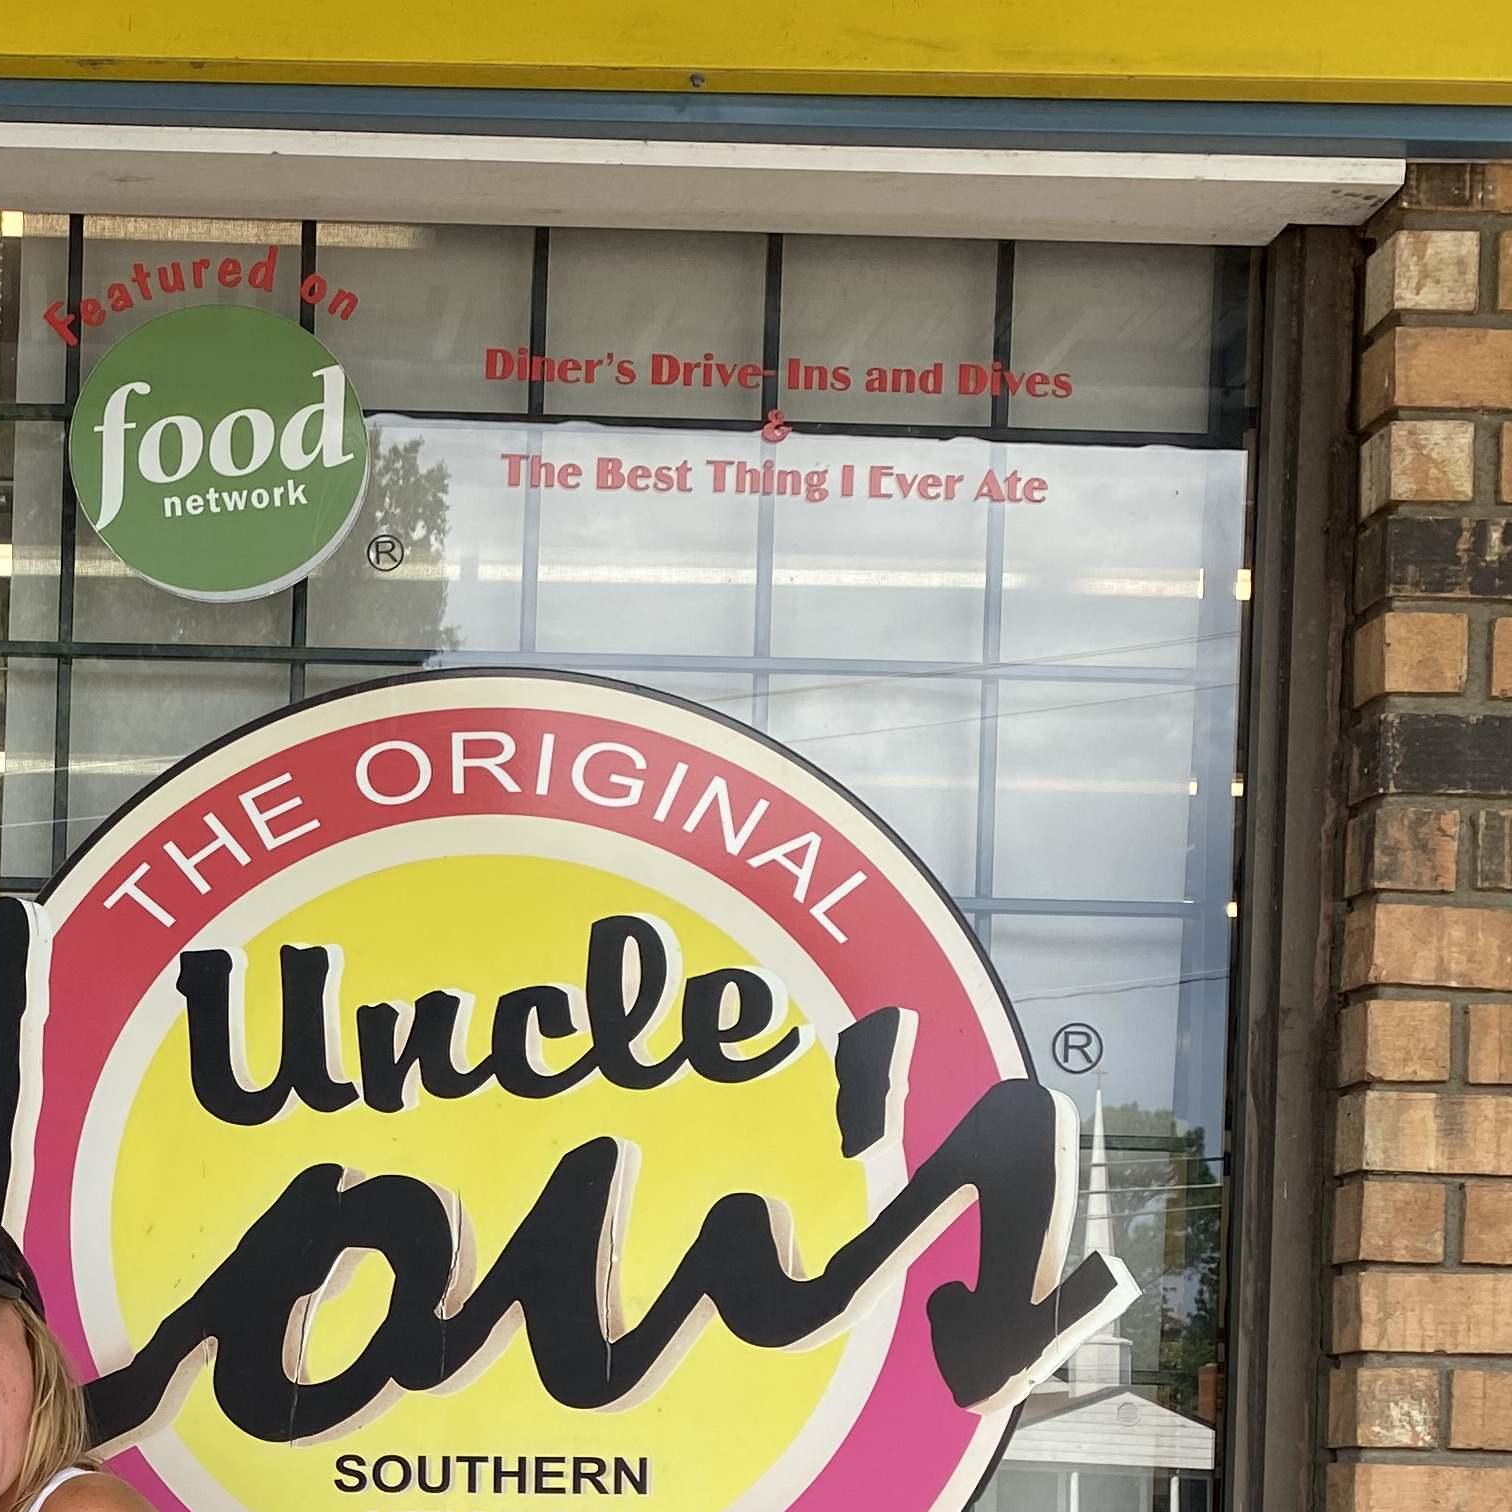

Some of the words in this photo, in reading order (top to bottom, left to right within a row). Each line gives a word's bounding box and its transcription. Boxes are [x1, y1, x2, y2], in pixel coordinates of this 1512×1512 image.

[43, 245, 279, 346] Featured
[300, 273, 359, 321] on
[485, 346, 637, 386] Diner's
[864, 363, 944, 395] and
[958, 361, 1074, 398] Dives
[93, 364, 355, 532] food
[761, 408, 793, 442] &
[163, 479, 308, 518] network
[500, 452, 583, 489] The
[596, 456, 693, 493] Best
[705, 459, 830, 503] Thing
[841, 464, 856, 497] I
[868, 465, 965, 500] Ever
[974, 469, 1050, 503] Ate
[103, 772, 322, 929] THE
[354, 731, 869, 945] ORIGINAL
[176, 914, 814, 1127] Uncle
[334, 1455, 649, 1496] SOUTHERN
